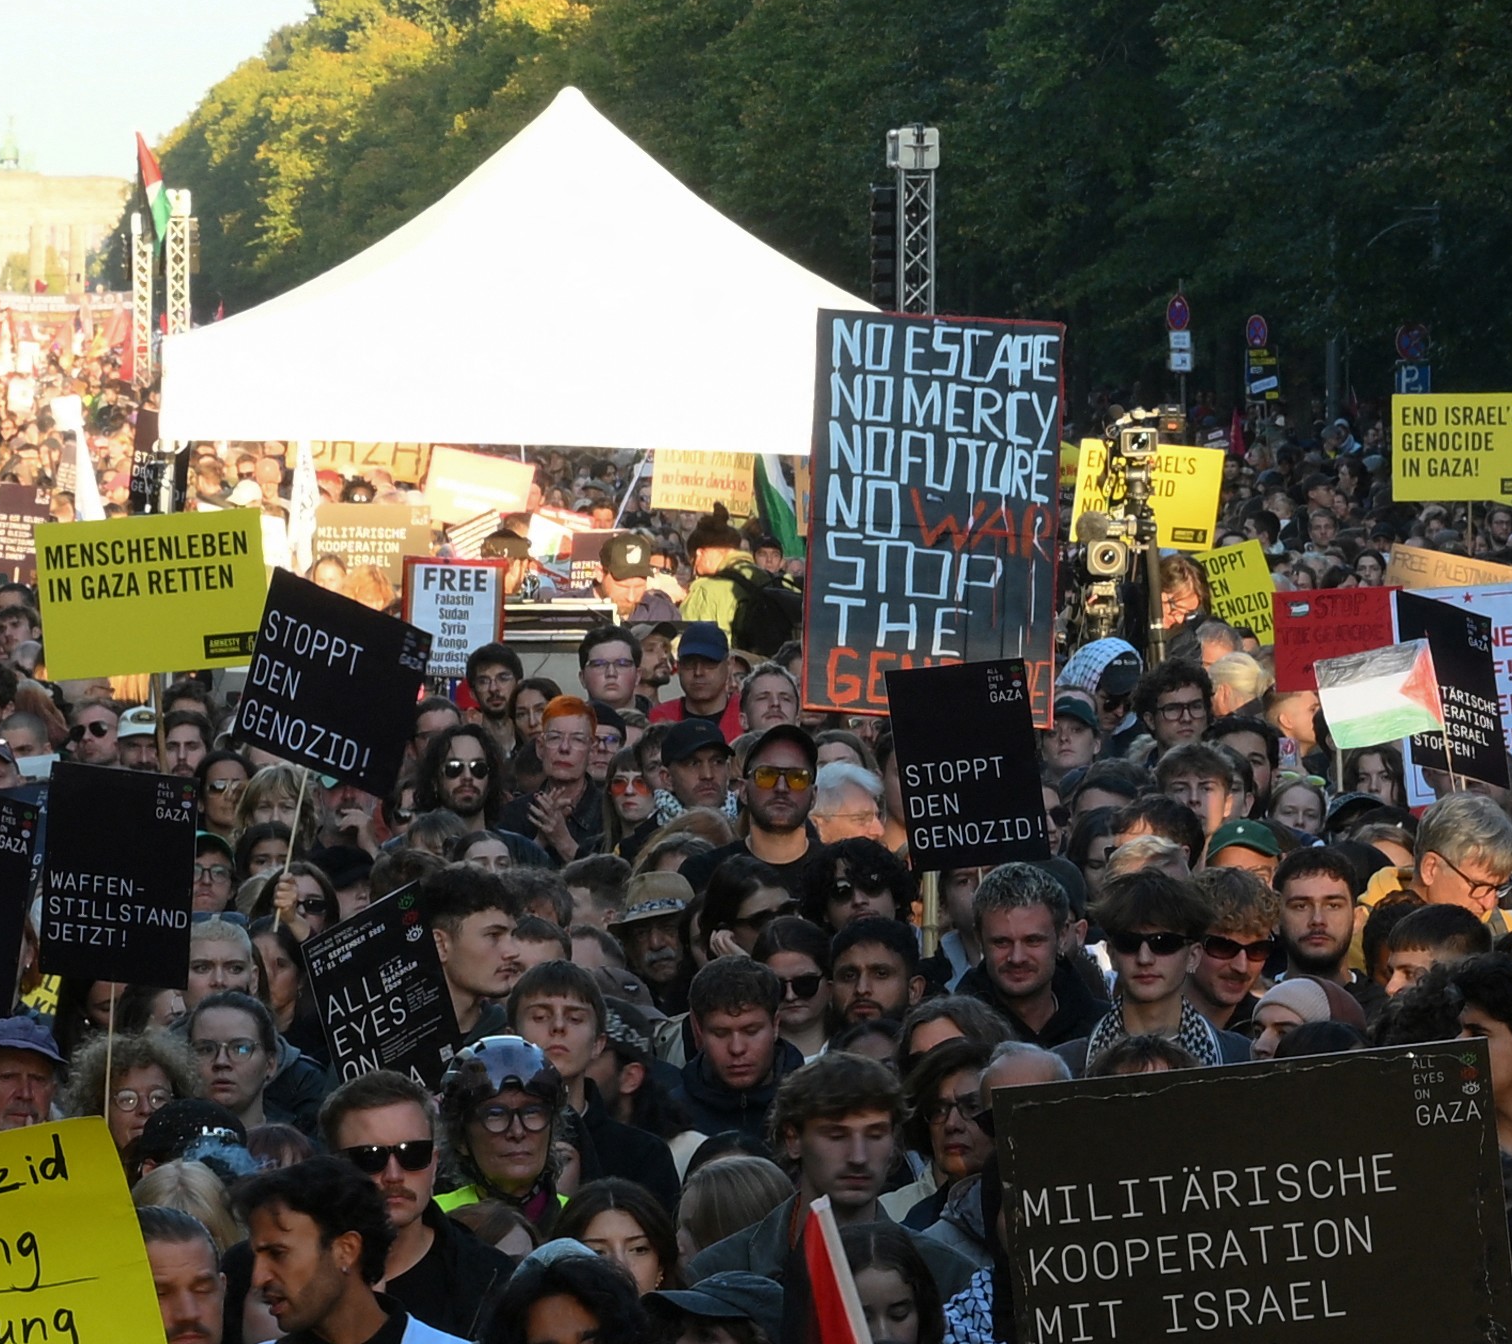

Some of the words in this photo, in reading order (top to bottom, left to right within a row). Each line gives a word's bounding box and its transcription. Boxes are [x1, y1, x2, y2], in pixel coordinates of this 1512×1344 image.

[831, 317, 894, 373] NO
[904, 326, 1060, 387] ESCAPE
[831, 372, 894, 423] NO
[903, 378, 1057, 451] MERCY
[1401, 406, 1437, 427] END
[1401, 431, 1494, 452] GENOCIDE
[829, 421, 894, 478] NO
[900, 431, 1053, 504] FUTURE
[1402, 457, 1419, 478] IN
[1427, 456, 1480, 478] GAZA!
[317, 523, 407, 541] MILITÄRISCHE
[826, 474, 900, 539] NO
[909, 487, 1054, 561] WAR
[43, 531, 249, 570] MENSCHENLEBEN
[317, 540, 400, 554] KOOPERATION
[423, 568, 488, 592] FREE
[826, 532, 1003, 601] STOP
[48, 574, 74, 603] IN
[80, 570, 142, 601] GAZA
[146, 564, 234, 595] RETTEN
[435, 594, 474, 606] Falastin
[439, 608, 469, 620] Sudan
[441, 622, 466, 635] Syria
[824, 596, 973, 657] THE
[263, 609, 365, 676] STOPPT
[437, 637, 468, 650] Kongo
[252, 653, 301, 701] DEN
[989, 689, 1023, 704] GAZA
[240, 698, 373, 776] GENOZID!
[906, 755, 1004, 788] STOPPT
[155, 807, 190, 823] GAZA
[909, 792, 960, 819] DEN
[913, 816, 1045, 851] GENOZID!
[49, 870, 145, 898] WAFFEN-
[49, 895, 188, 930] STILLSTAND
[47, 922, 128, 948] JETZT!
[1416, 1099, 1482, 1127] GAZA
[1022, 1152, 1398, 1228] MILITÄRISCHE
[1029, 1215, 1374, 1287] KOOPERATION
[1163, 1279, 1347, 1334] ISRAEL
